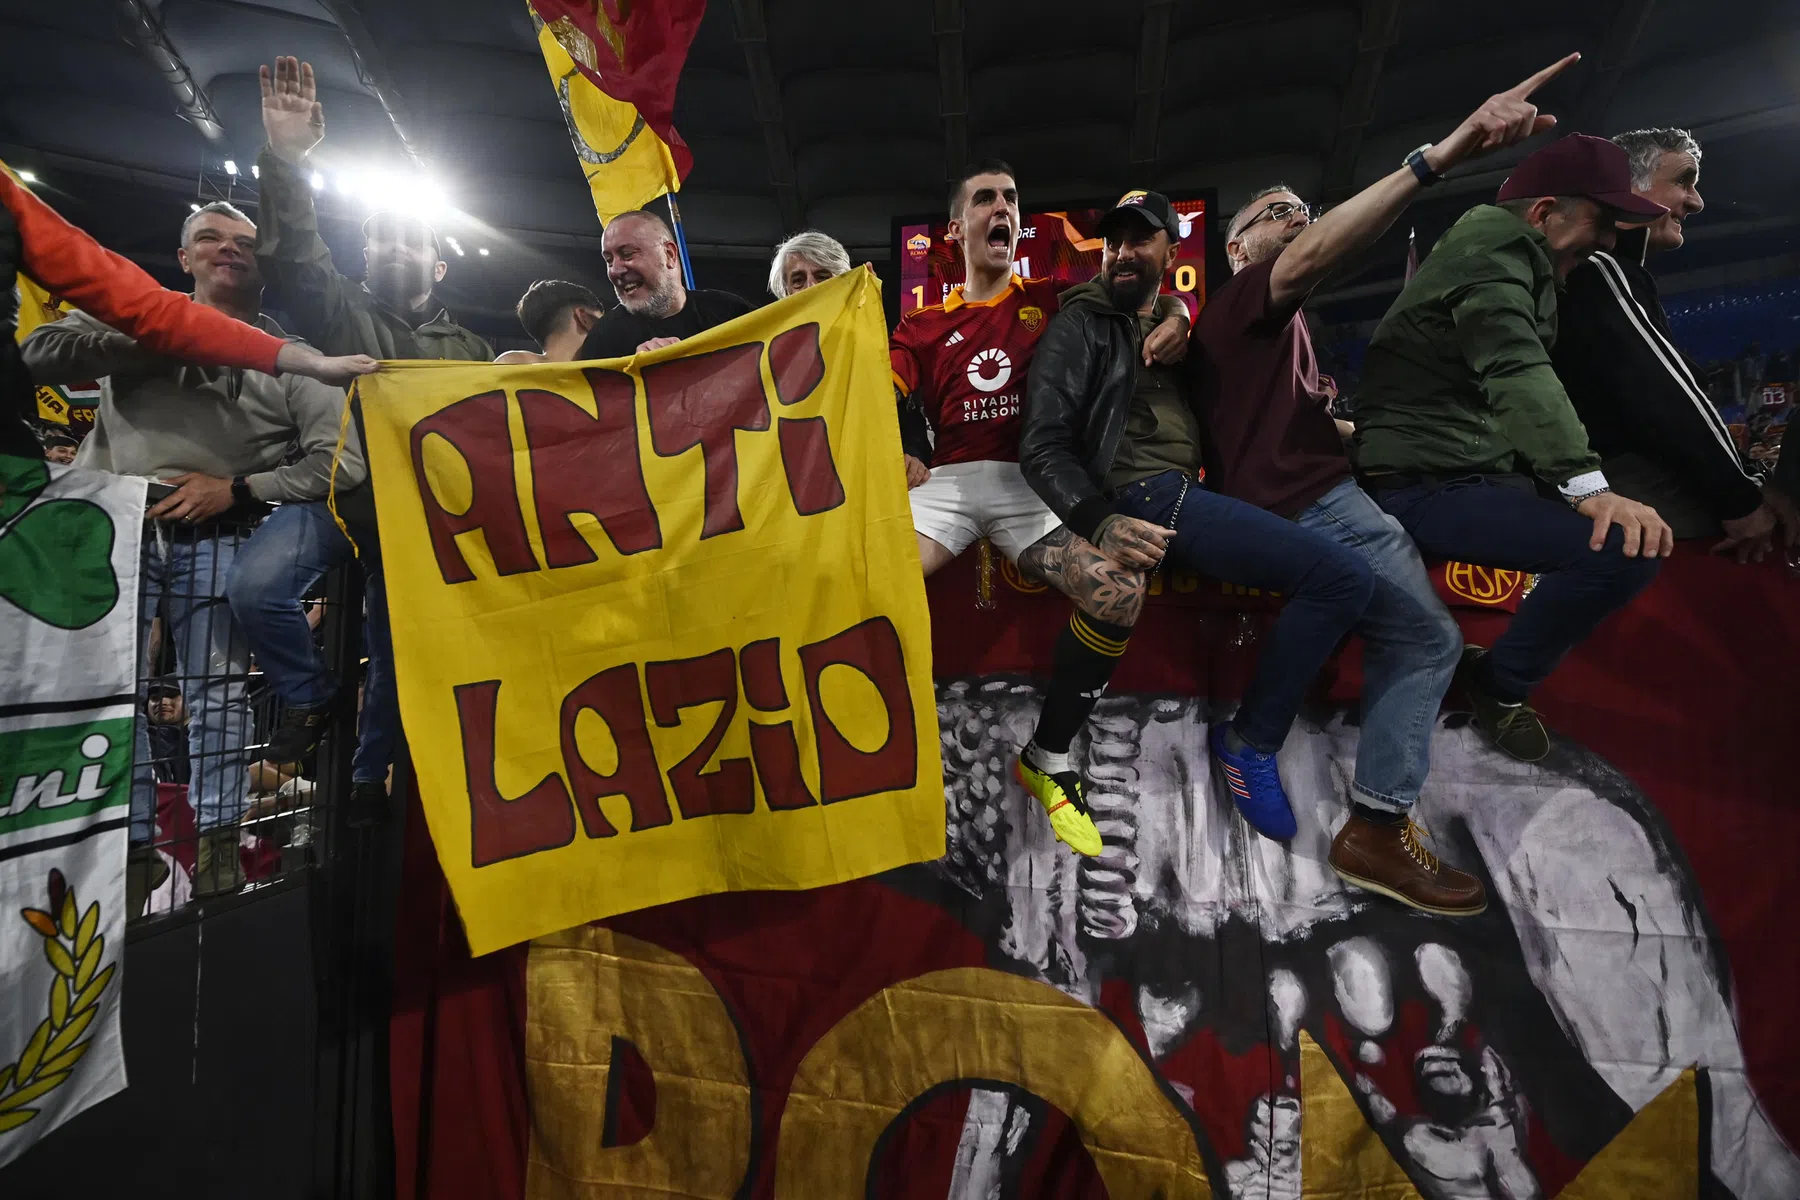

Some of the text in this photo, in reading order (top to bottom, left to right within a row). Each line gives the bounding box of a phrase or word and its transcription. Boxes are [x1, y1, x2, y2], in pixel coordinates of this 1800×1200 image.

[1175, 265, 1197, 292] 0
[911, 285, 924, 309] 1
[963, 394, 1020, 411] RIYADH
[963, 406, 1020, 422] SEASON
[0, 733, 112, 818] ni
